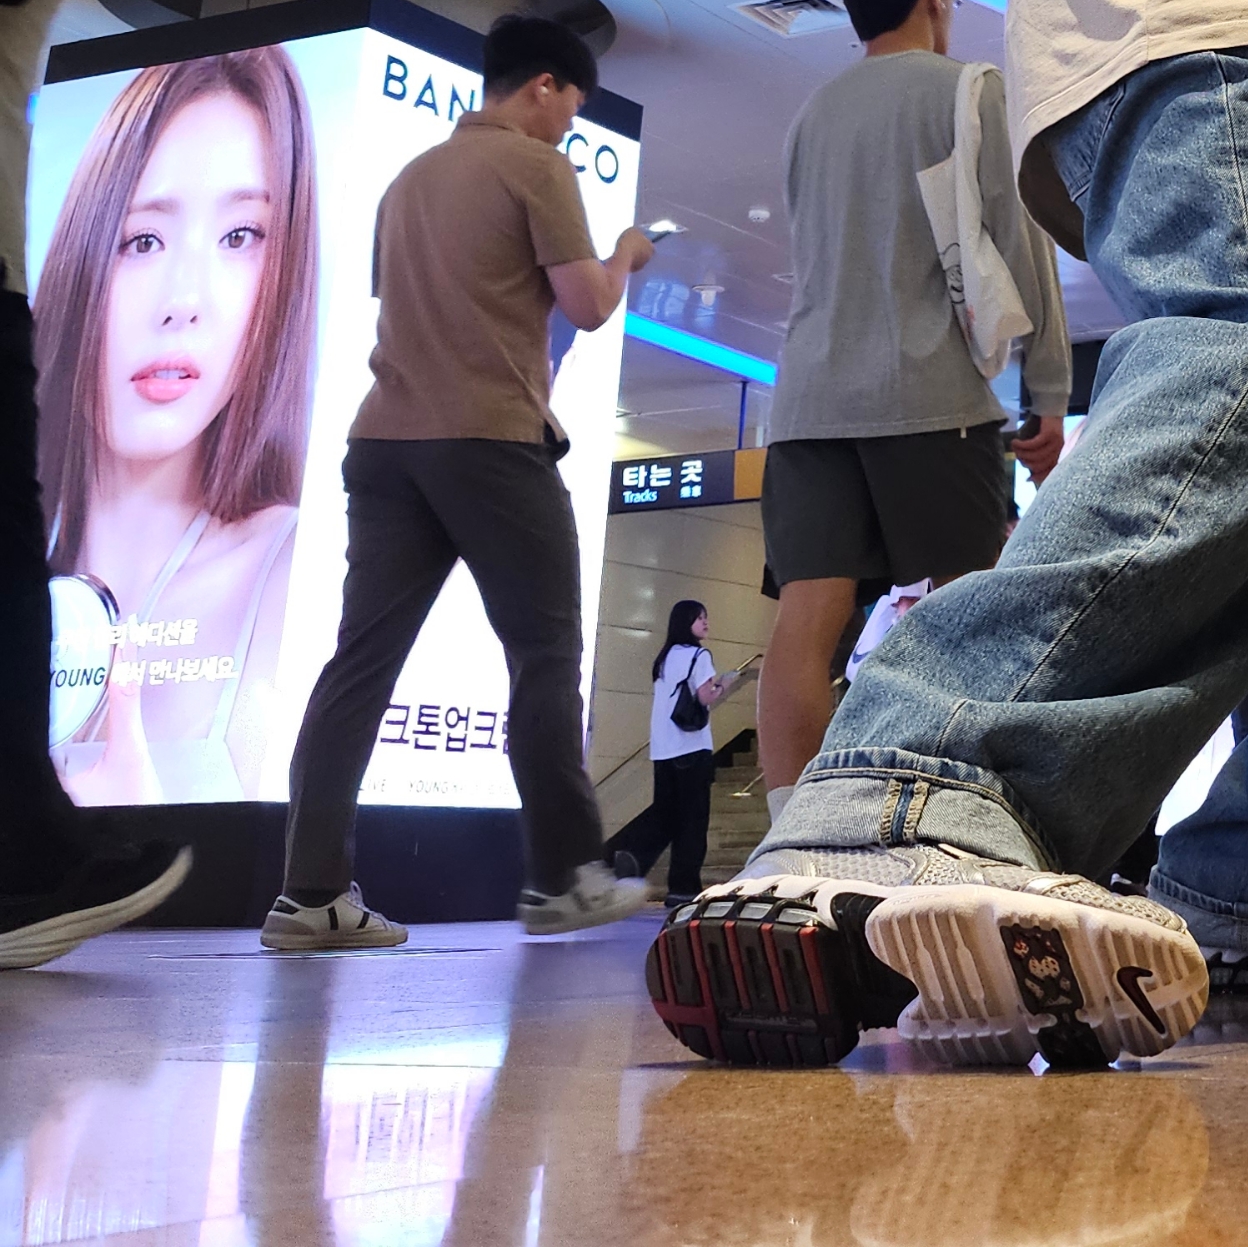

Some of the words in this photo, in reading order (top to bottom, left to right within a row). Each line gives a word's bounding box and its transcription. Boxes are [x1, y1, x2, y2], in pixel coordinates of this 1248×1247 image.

[382, 54, 476, 122] BAN
[566, 133, 619, 183] CO
[622, 464, 672, 488] 타는
[680, 460, 703, 484] 곳
[622, 489, 658, 504] Tracks
[380, 704, 510, 755] 크톤업크
